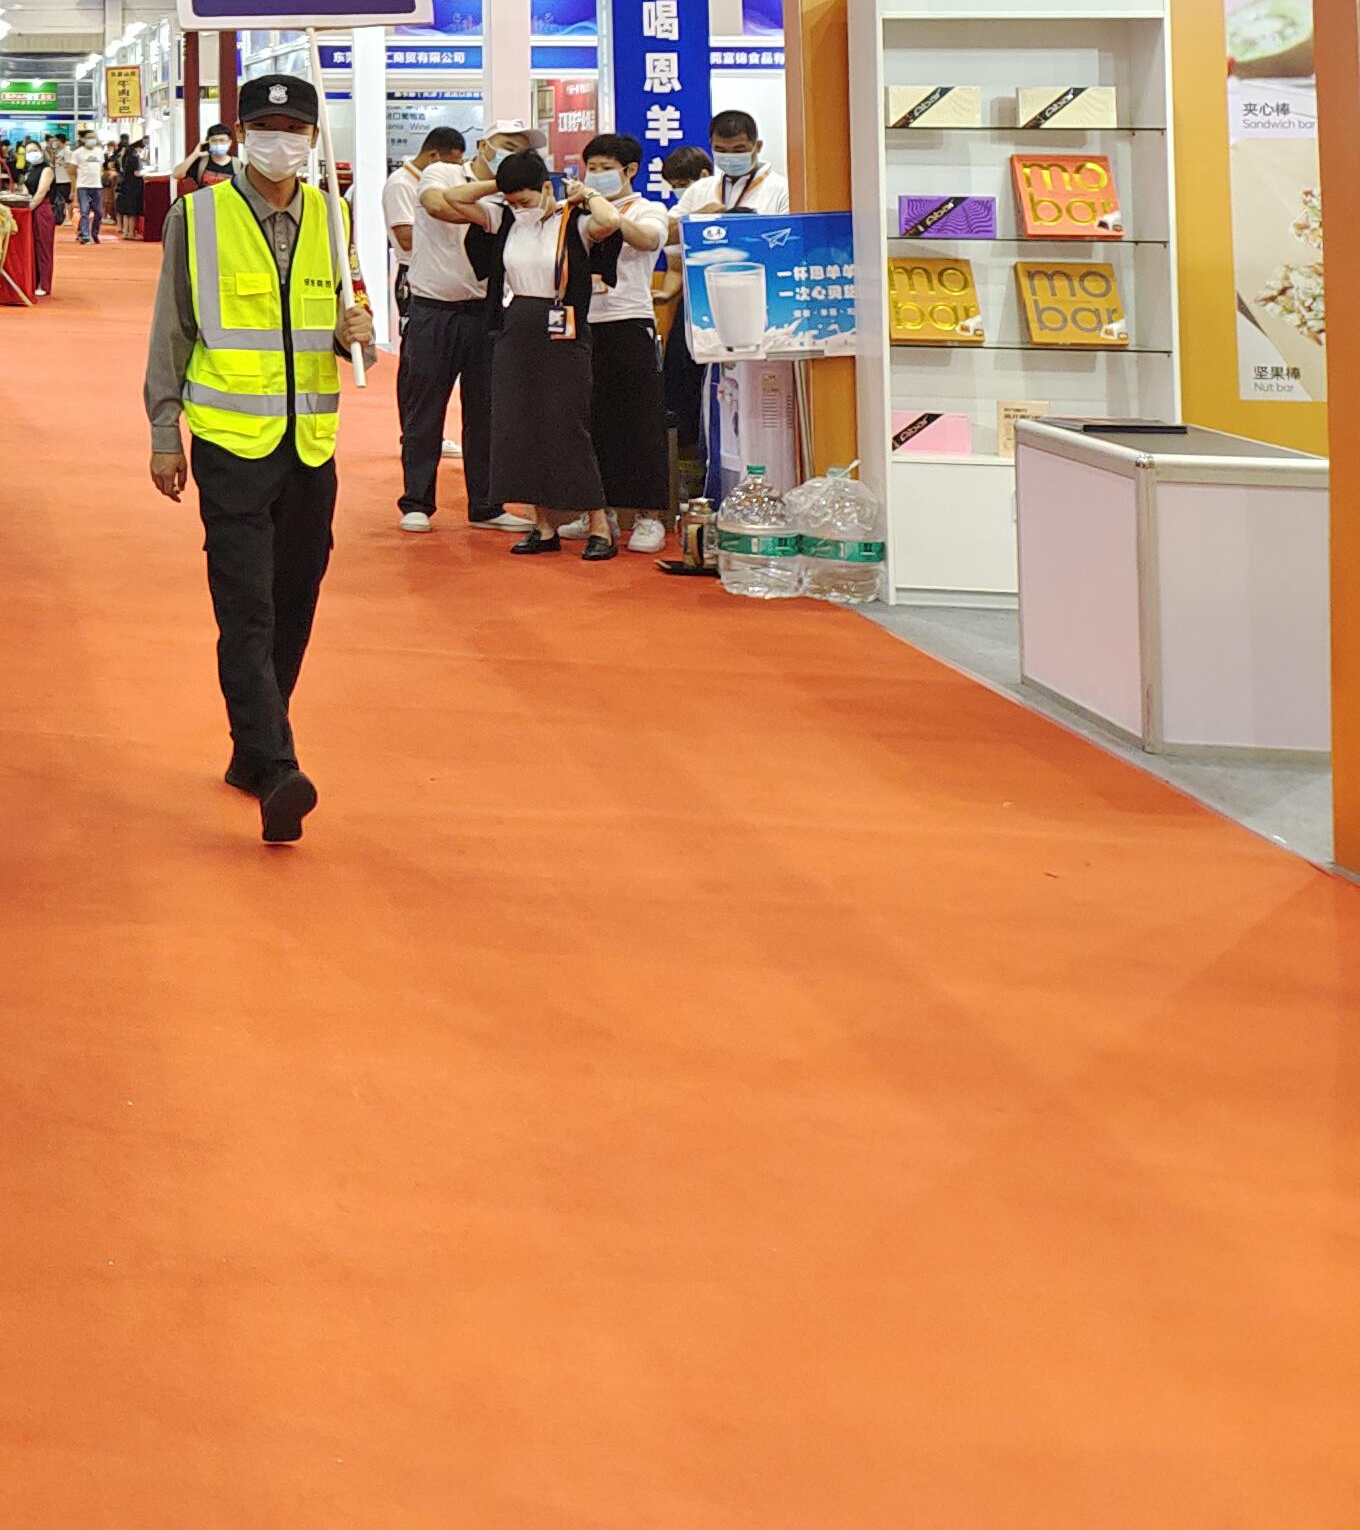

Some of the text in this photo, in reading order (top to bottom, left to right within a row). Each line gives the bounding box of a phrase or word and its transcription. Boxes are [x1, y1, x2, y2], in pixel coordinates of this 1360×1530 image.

[1243, 102, 1290, 117] 夹心棒
[1243, 118, 1315, 130] Sandwich bar
[1023, 162, 1108, 192] mo
[1030, 190, 1114, 226] bar
[890, 266, 969, 296] mo
[1027, 270, 1112, 299] mo
[896, 296, 977, 331] bar
[1033, 298, 1119, 333] bar
[1253, 366, 1301, 381] 坚果棒
[1253, 381, 1294, 393] Nut bar
